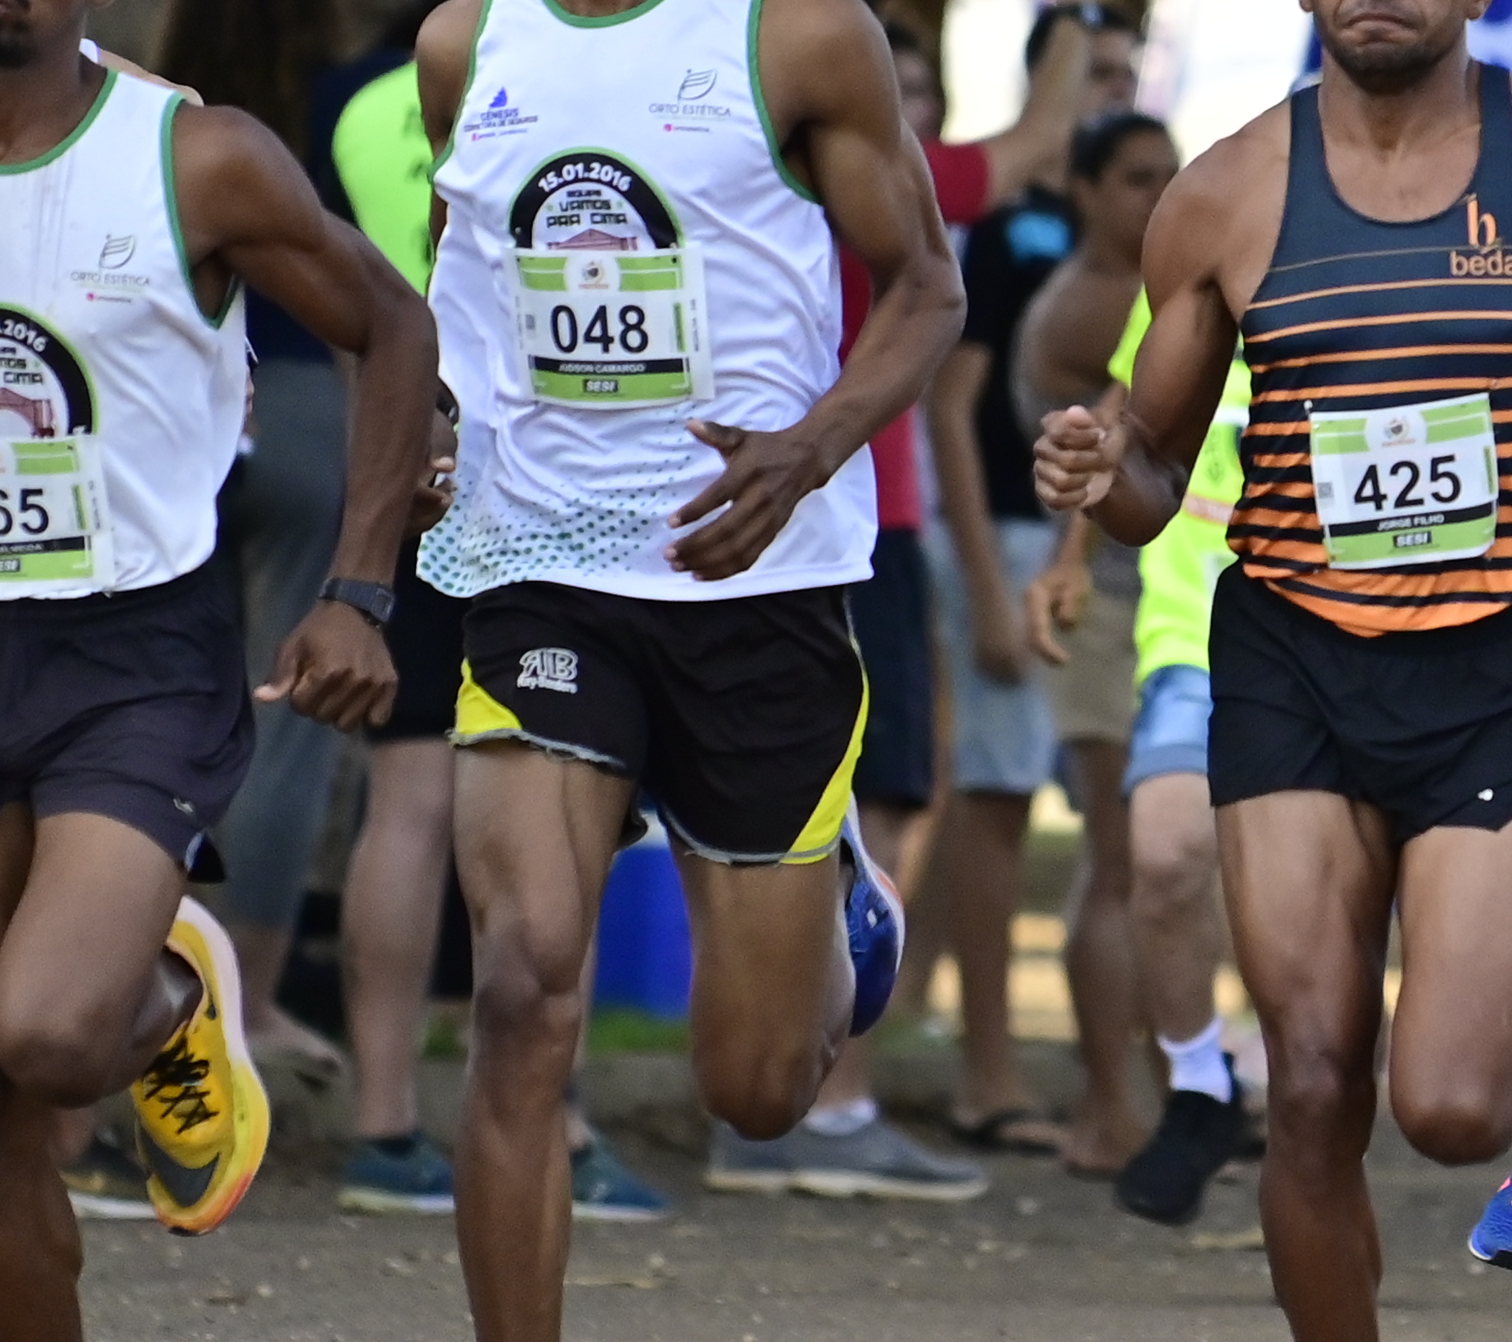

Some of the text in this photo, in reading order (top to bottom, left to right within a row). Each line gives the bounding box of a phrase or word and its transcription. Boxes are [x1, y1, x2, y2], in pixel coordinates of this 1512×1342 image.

[538, 162, 632, 192] 15.01.2016
[558, 199, 612, 212] VAMOS
[549, 304, 649, 354] 048
[586, 380, 617, 392] SESI
[1354, 454, 1462, 511] 425
[1378, 514, 1445, 531] JORGE FILHO
[1396, 533, 1429, 546] SESI
